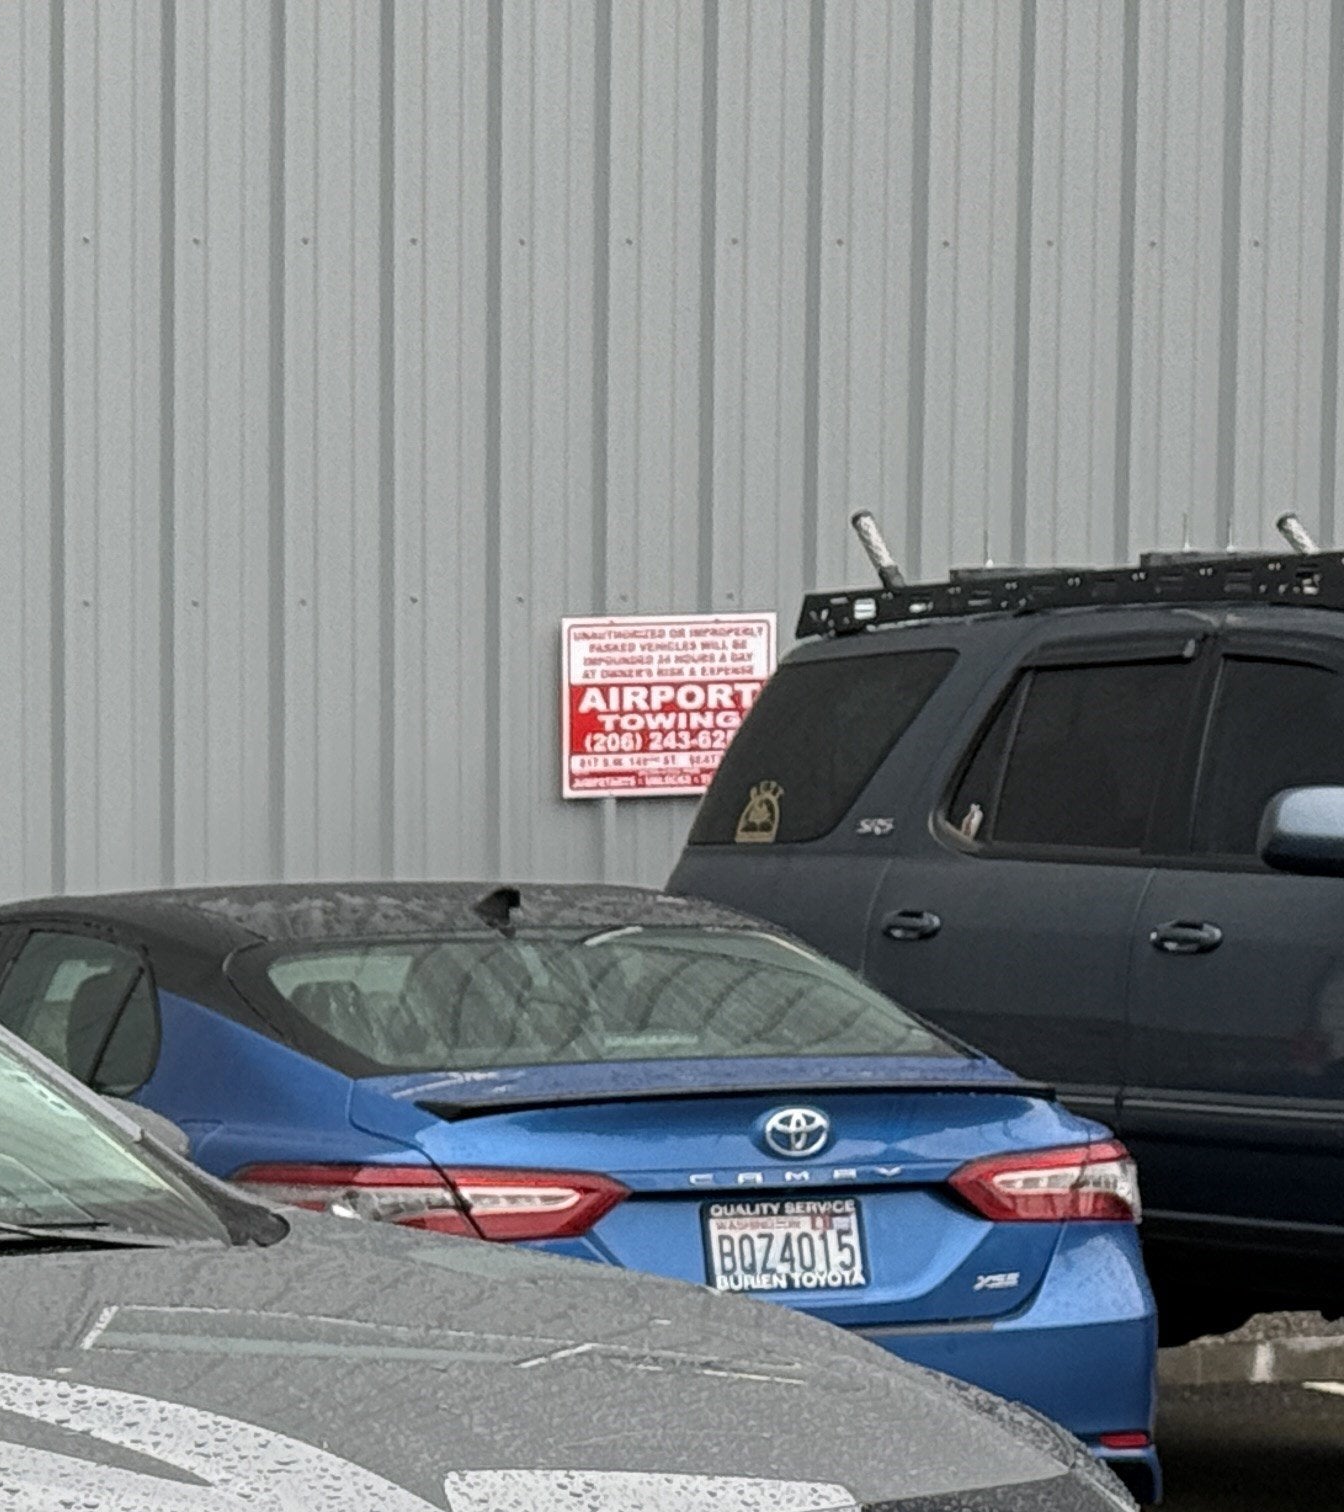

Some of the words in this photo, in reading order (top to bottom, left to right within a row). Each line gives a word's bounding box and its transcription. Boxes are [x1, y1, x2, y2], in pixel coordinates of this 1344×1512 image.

[669, 628, 686, 639] OR
[640, 641, 697, 652] VEHICLES
[701, 640, 728, 651] WILL
[730, 652, 754, 662] DAY
[582, 669, 597, 679] AT
[578, 682, 761, 713] AIRPORT
[597, 710, 742, 731] TOWING
[584, 731, 643, 752] (206)
[648, 729, 735, 750] 243-62
[689, 1165, 903, 1185] CAMRY
[710, 1202, 781, 1217] QUALITY
[785, 1199, 856, 1215] SERVICE
[718, 1229, 856, 1276] BQZ4015
[716, 1272, 787, 1291] BURIEN
[791, 1271, 866, 1289] TOYOTA
